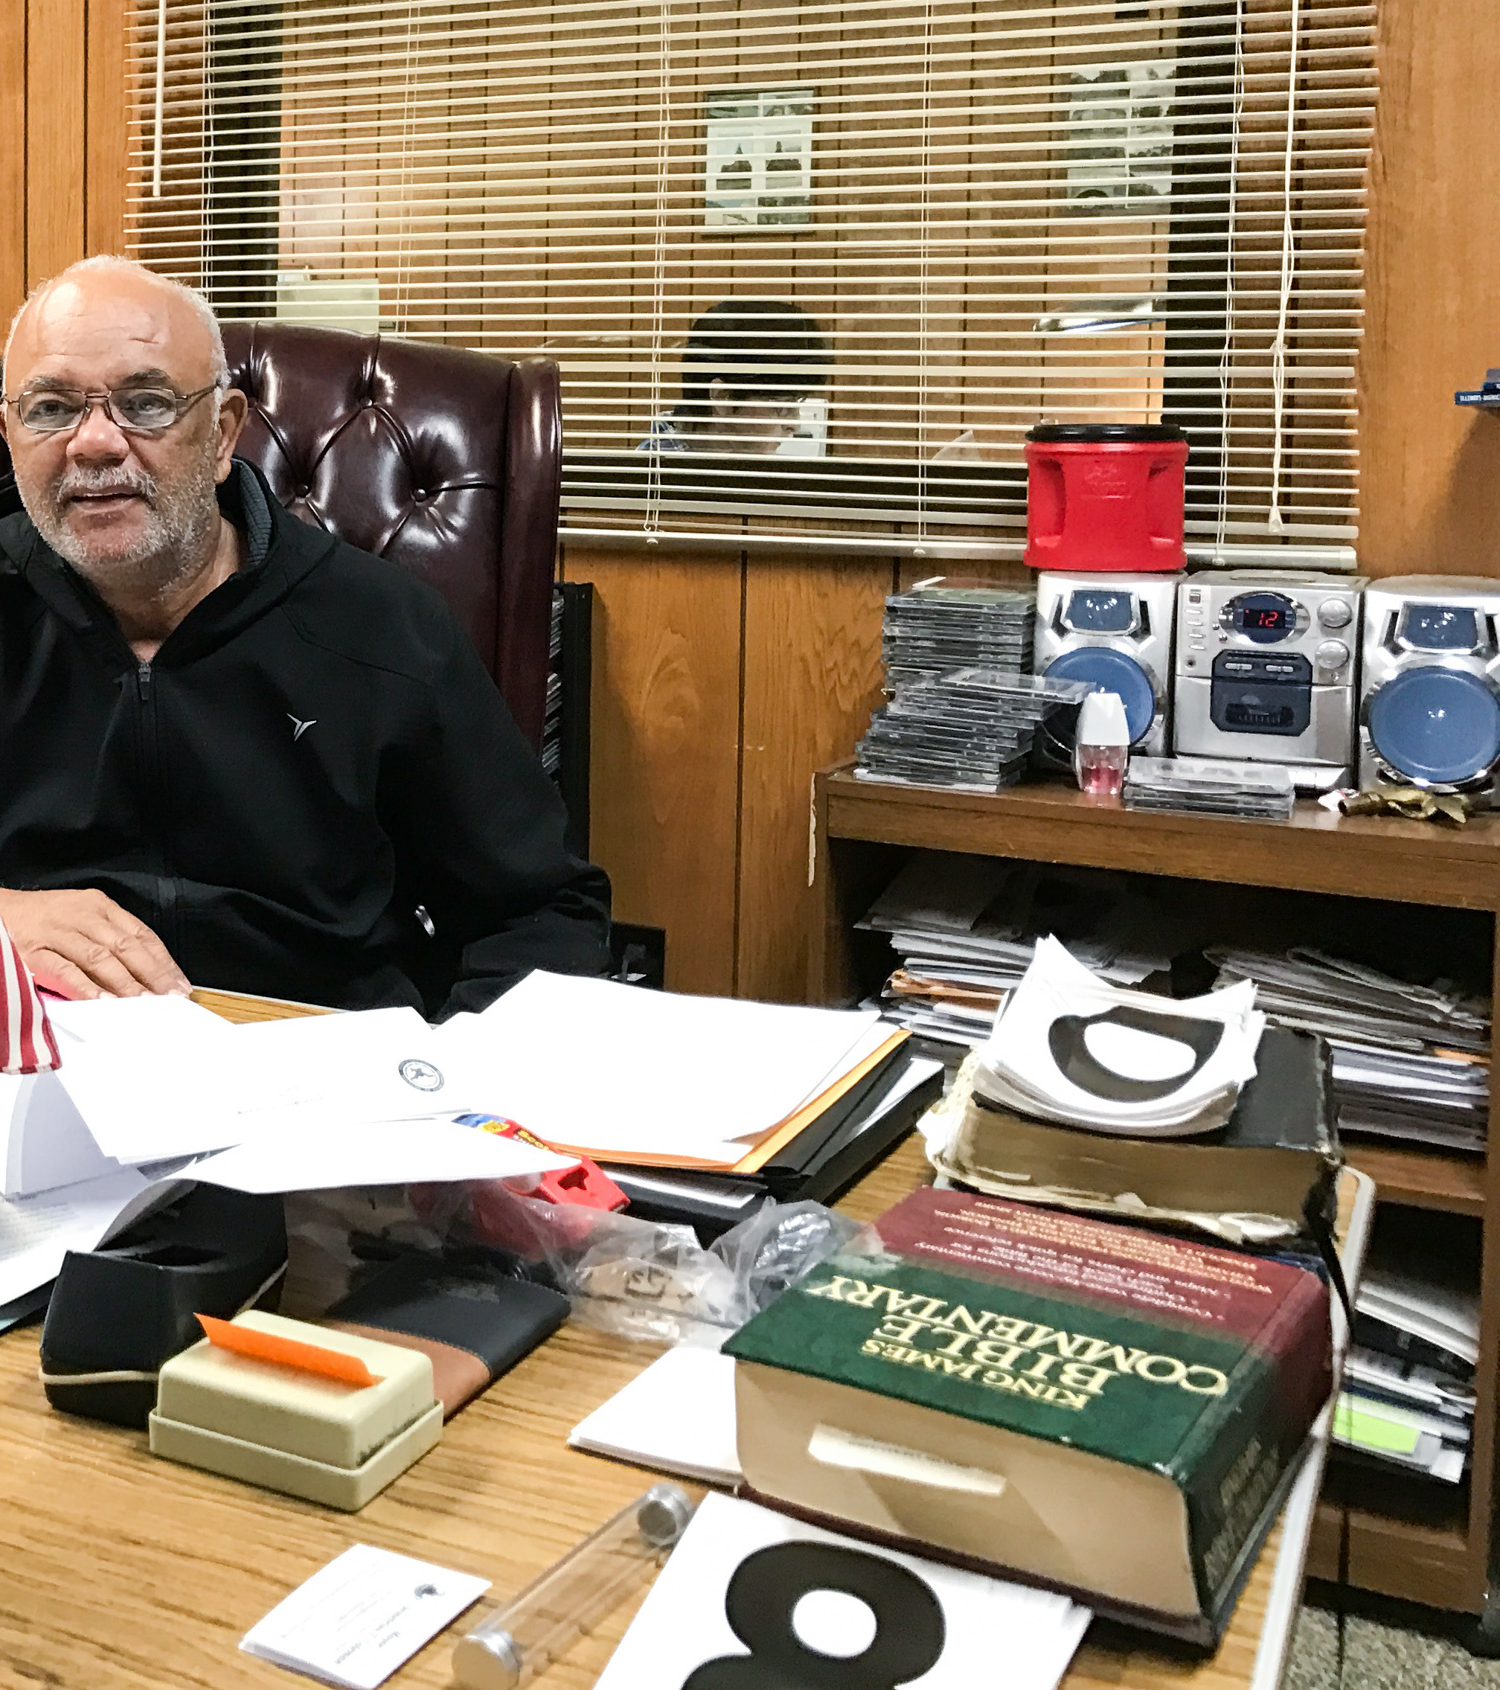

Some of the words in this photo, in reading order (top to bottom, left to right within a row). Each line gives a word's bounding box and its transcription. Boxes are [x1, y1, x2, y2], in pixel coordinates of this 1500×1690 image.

[1257, 611, 1279, 628] 12
[944, 1227, 1011, 1245] reference
[1017, 1243, 1056, 1255] quick
[1088, 1259, 1135, 1273] charts
[1138, 1271, 1170, 1282] and
[1174, 1280, 1217, 1295] Maps
[806, 1274, 1230, 1397] COMMENTARY
[861, 1338, 978, 1377] JAMES
[872, 1313, 1121, 1396] BIBLE
[982, 1369, 1091, 1411] KING
